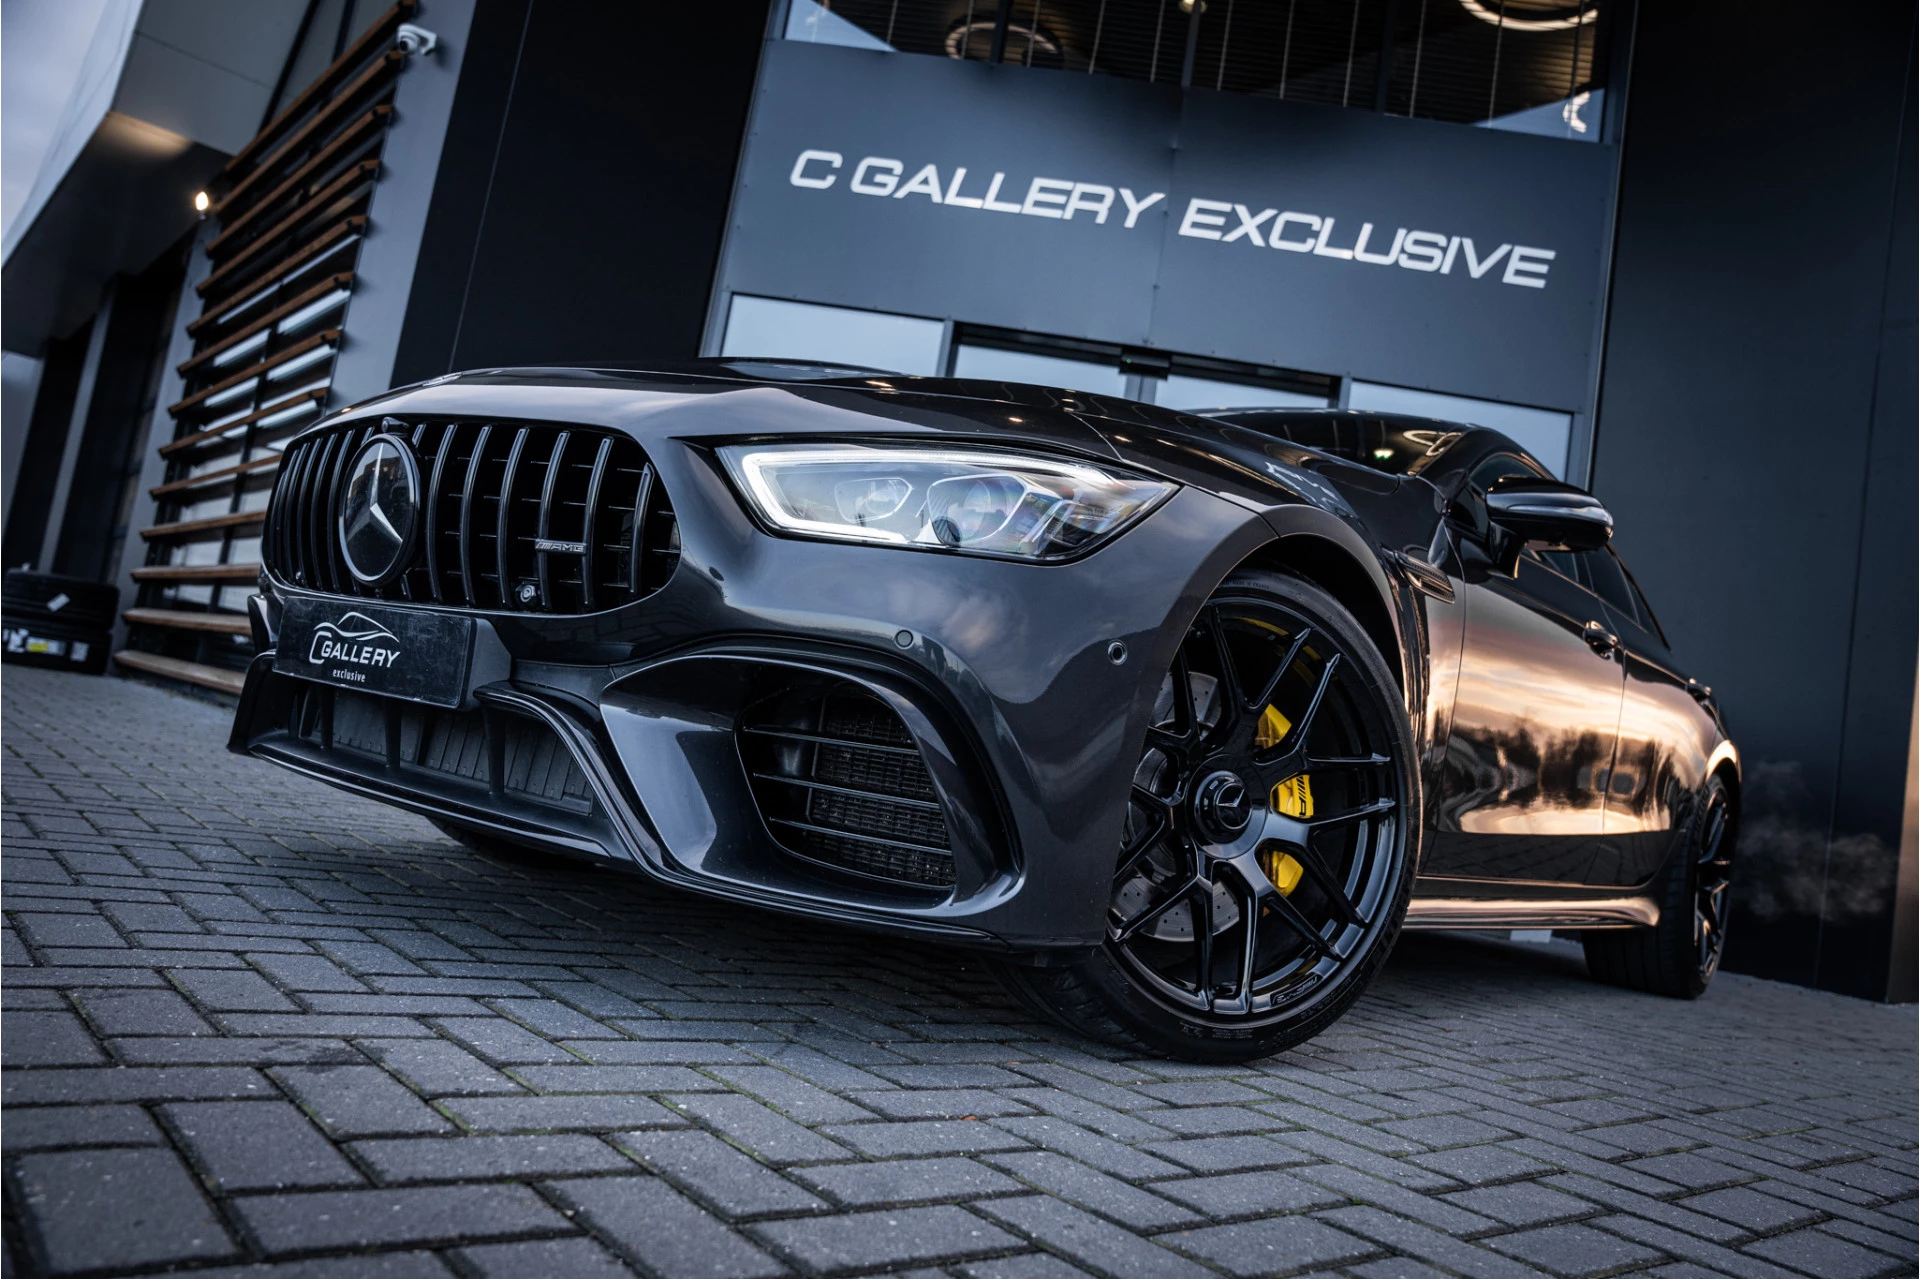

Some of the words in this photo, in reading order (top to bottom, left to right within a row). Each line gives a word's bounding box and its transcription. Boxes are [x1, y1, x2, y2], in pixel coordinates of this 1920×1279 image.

[789, 149, 843, 190] C
[849, 156, 1166, 230] GALLERY
[1178, 198, 1556, 289] EXCLUSIVE
[549, 543, 585, 552] AMG
[332, 667, 366, 683] exclusive
